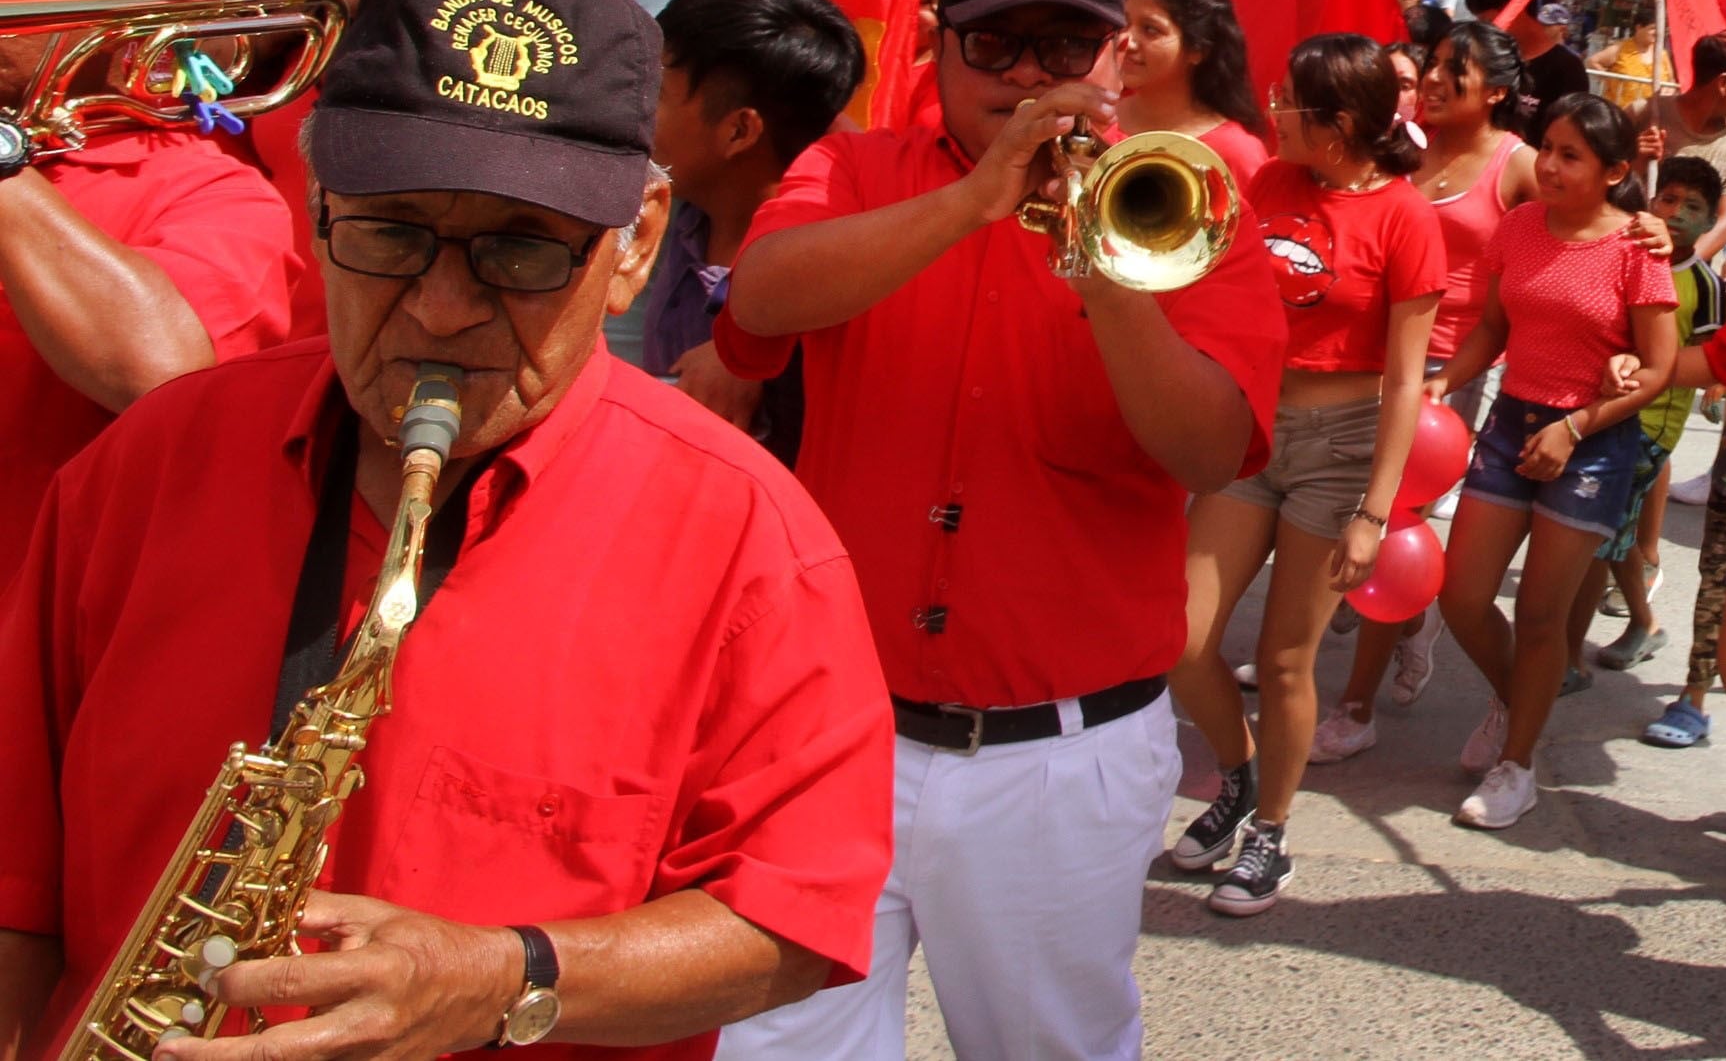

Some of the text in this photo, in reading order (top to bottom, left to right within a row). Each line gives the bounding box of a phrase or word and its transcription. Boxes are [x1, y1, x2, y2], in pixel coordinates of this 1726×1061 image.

[452, 8, 498, 51] RENACER
[522, 0, 579, 65] MUSICOS
[437, 75, 549, 120] CATACAOS
